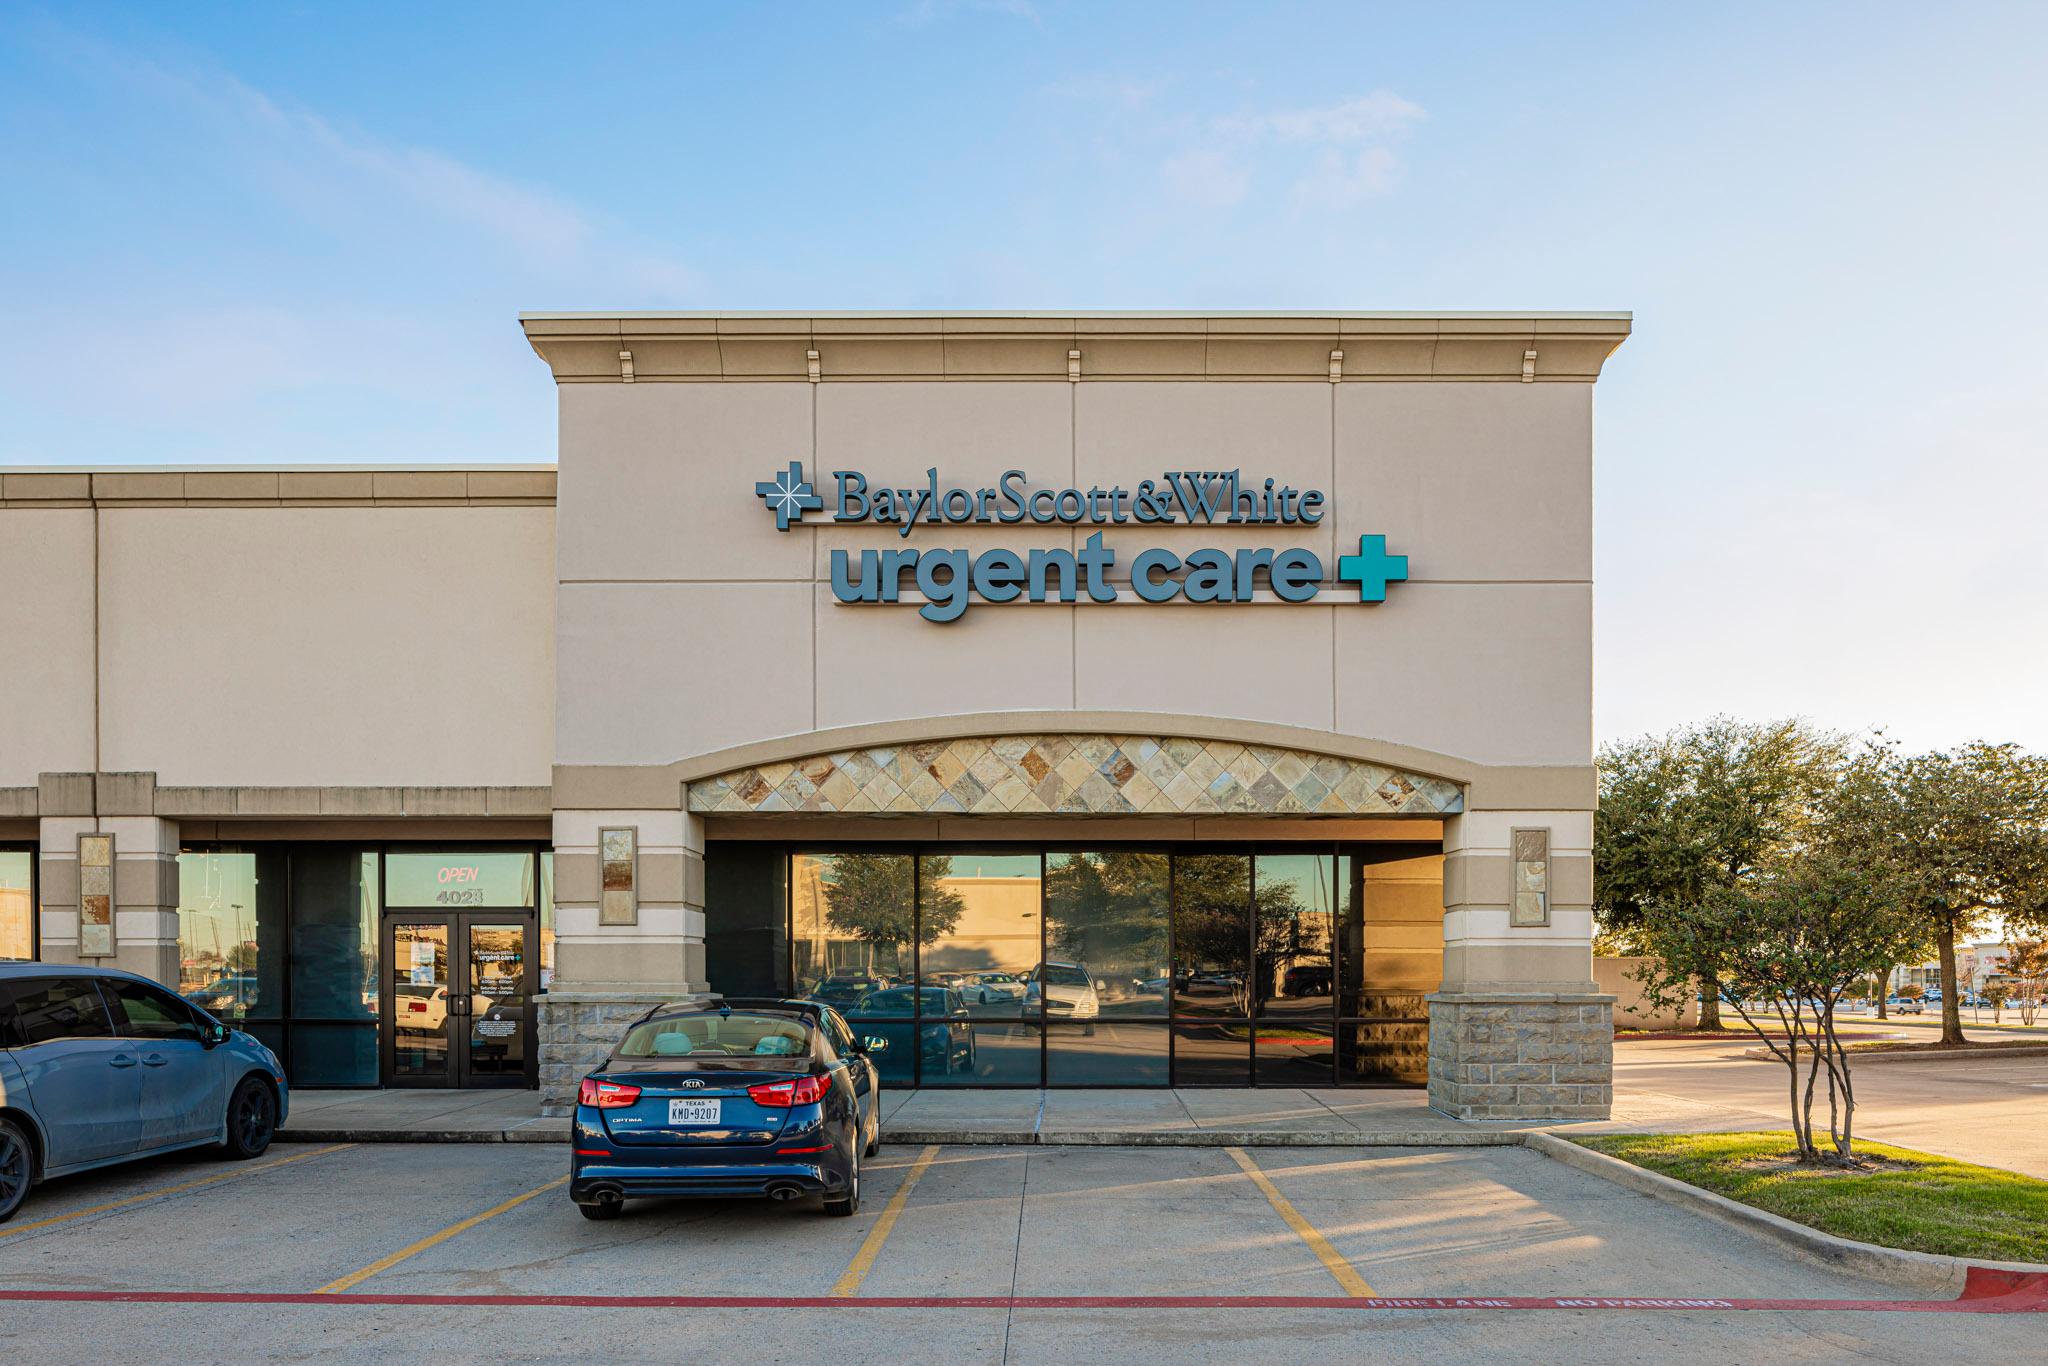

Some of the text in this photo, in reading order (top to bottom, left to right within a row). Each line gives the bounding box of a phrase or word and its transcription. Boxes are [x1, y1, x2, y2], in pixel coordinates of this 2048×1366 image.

[829, 531, 1323, 624] urgent care
[437, 866, 479, 884] OPEN
[479, 954, 500, 962] urgent
[1367, 1299, 1732, 1307] FIRE LANE NO PARKING
